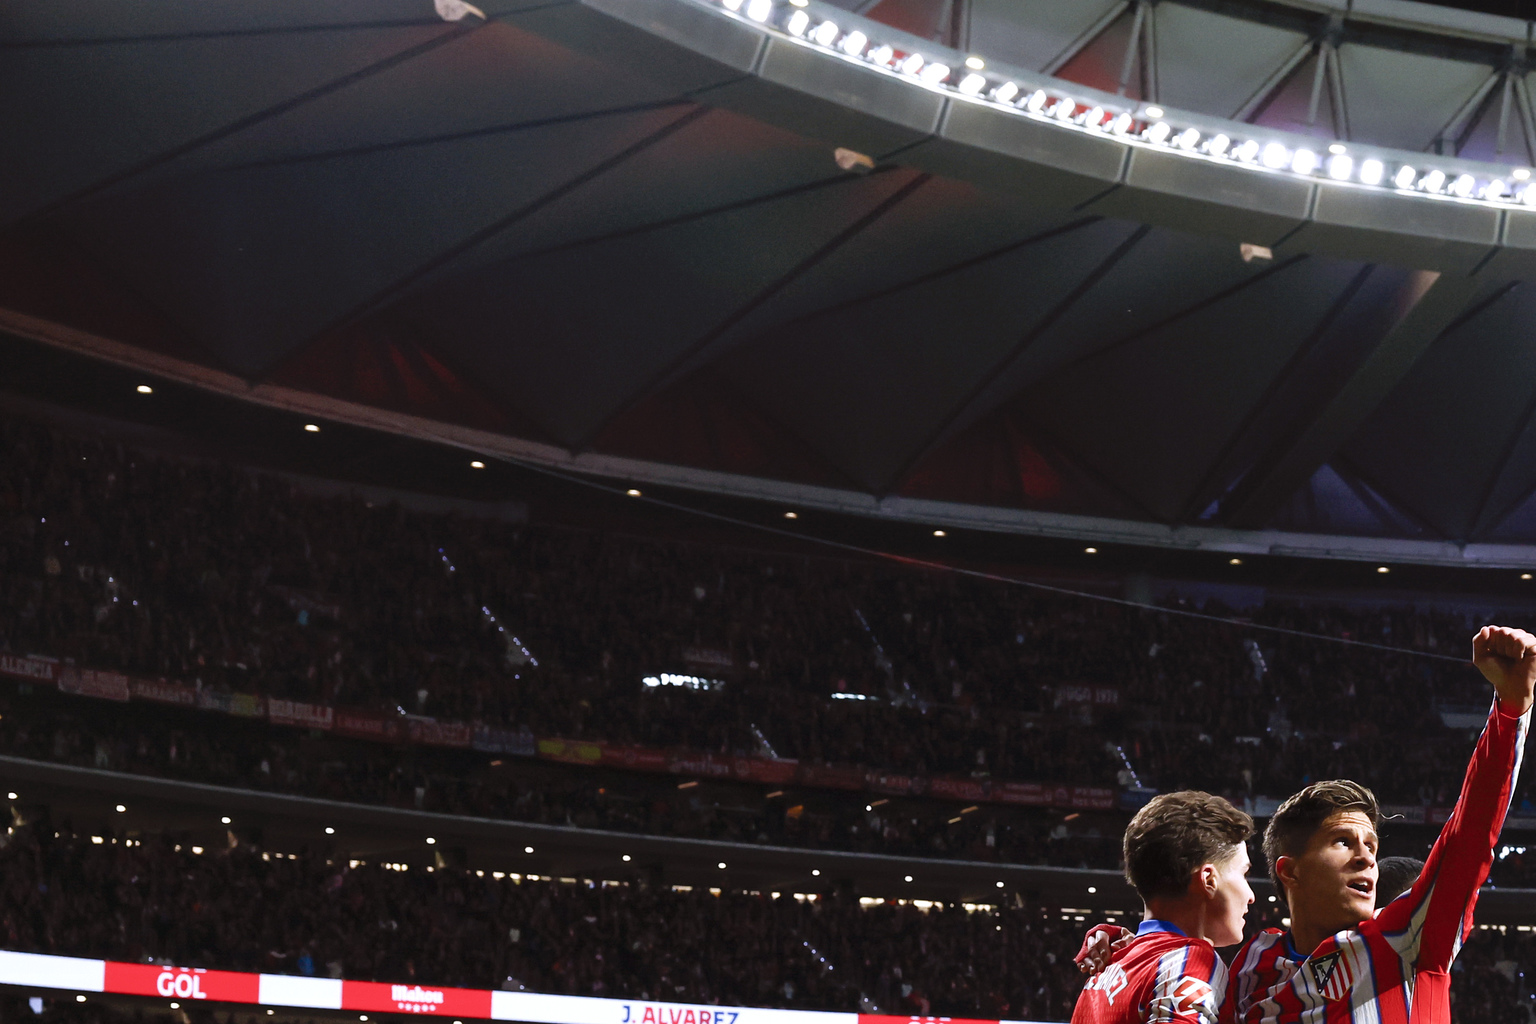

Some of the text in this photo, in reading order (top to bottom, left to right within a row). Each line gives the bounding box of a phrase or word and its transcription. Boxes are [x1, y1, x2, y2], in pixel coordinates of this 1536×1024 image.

[157, 972, 206, 999] GOL
[391, 984, 444, 1005] Mahou
[622, 1005, 636, 1024] J.
